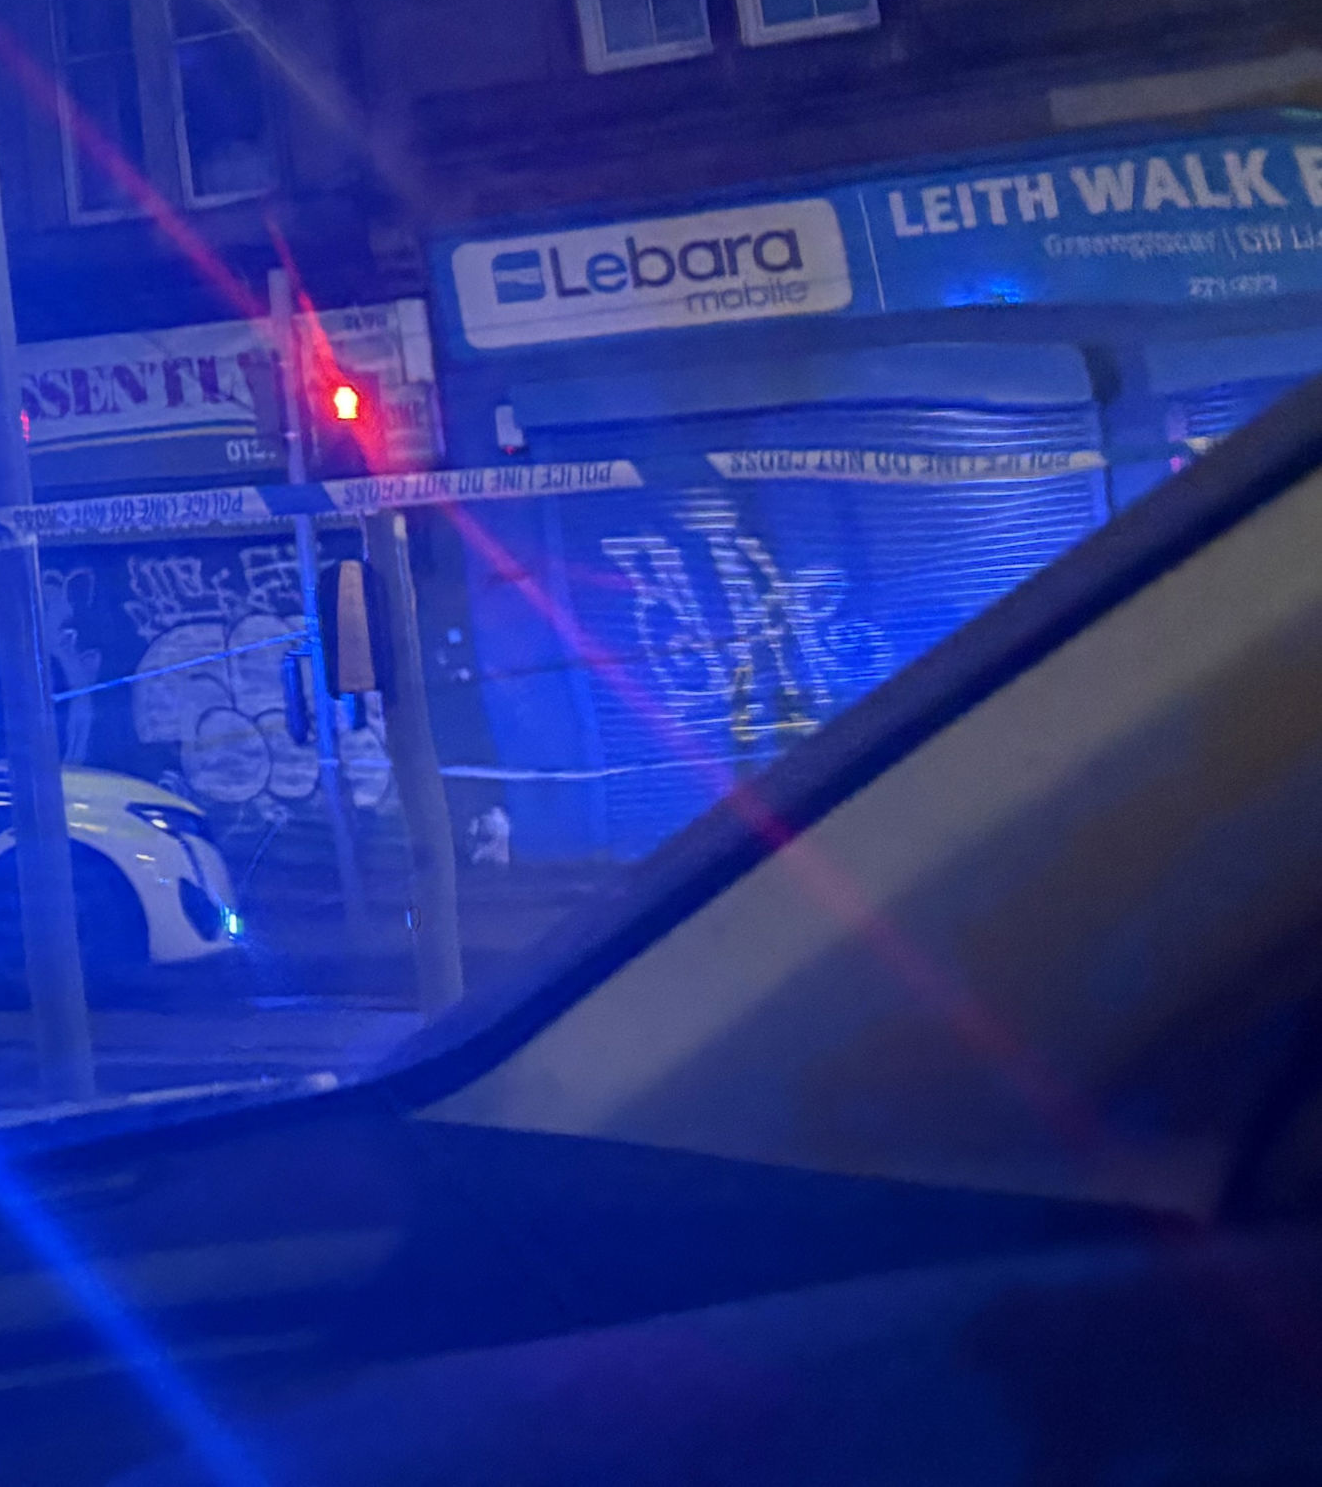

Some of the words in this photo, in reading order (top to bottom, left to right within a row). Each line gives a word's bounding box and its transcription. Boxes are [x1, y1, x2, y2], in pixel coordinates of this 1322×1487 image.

[888, 172, 1060, 238] LEITH
[1069, 148, 1288, 216] WALK
[549, 227, 804, 298] Lebara
[685, 279, 809, 315] mobile
[541, 462, 613, 488] POLICE
[730, 449, 808, 474] CROSS
[812, 448, 865, 475] NOT
[874, 452, 911, 477] DO
[343, 477, 408, 506] CROSS
[412, 473, 452, 500] NOT
[457, 469, 486, 495] DO
[493, 466, 534, 493] LINE
[139, 495, 178, 524] LINE
[184, 490, 245, 518] POLICE
